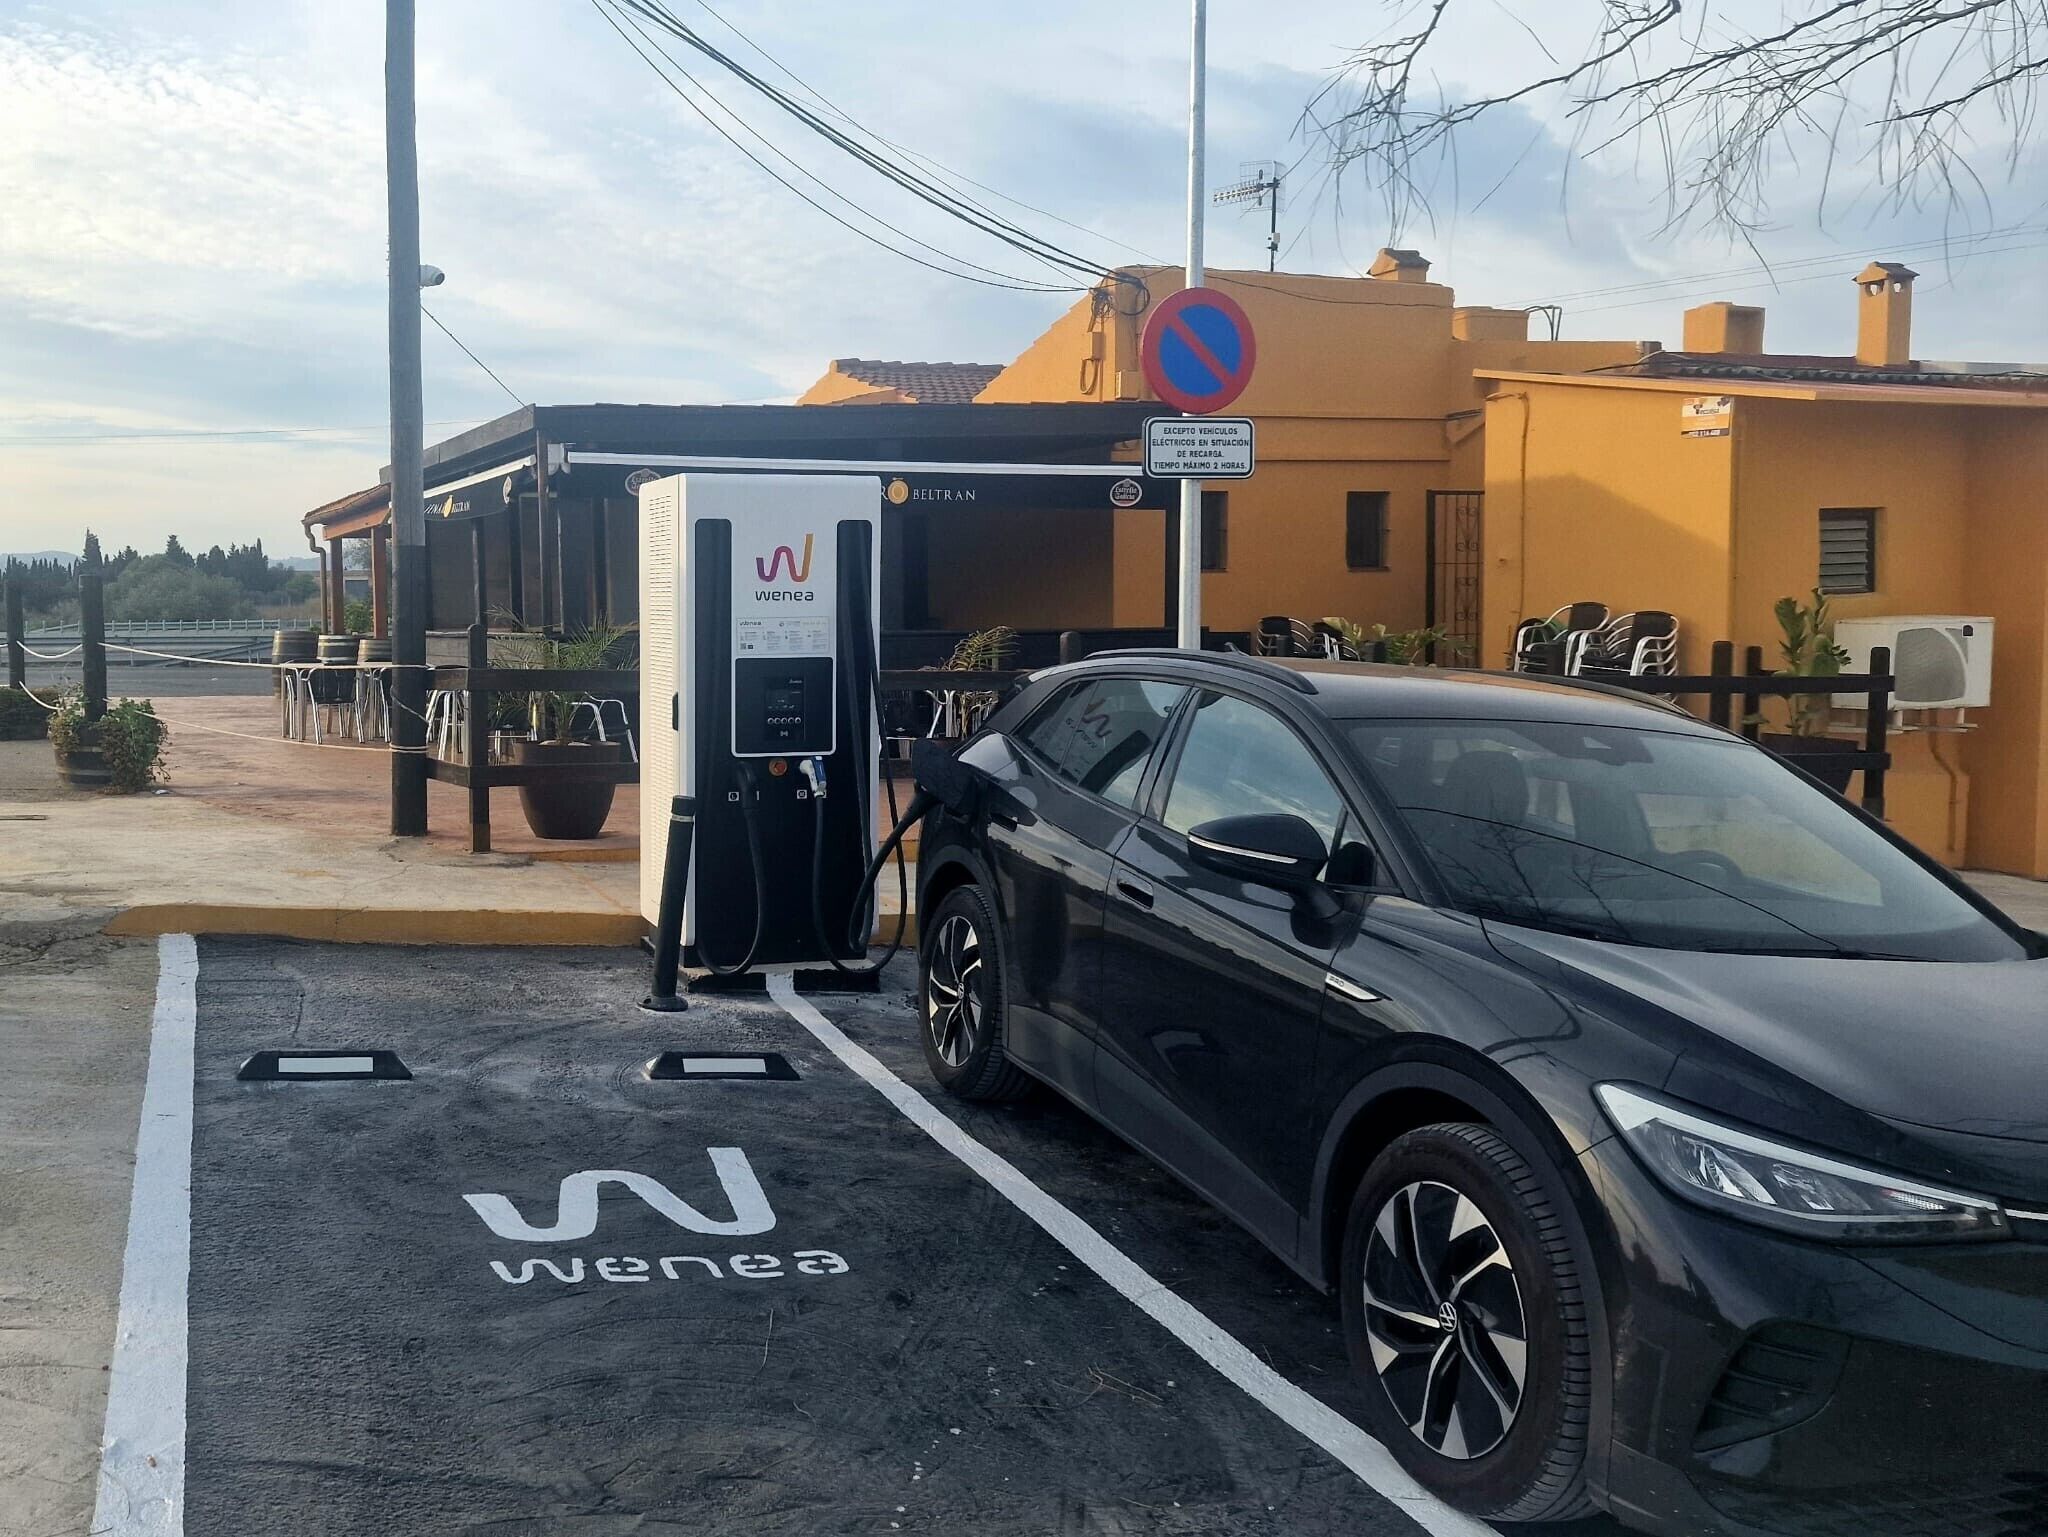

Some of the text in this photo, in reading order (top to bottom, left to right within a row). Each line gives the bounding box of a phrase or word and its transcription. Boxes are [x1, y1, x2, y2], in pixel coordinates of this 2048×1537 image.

[1164, 427, 1195, 435] EXCEPTO
[1152, 438, 1196, 446] ELÉCTRICOS
[1211, 438, 1249, 446] SITUACIÓN
[1183, 461, 1211, 469] MÁXIMO
[913, 488, 975, 501] BELTRAN
[755, 591, 814, 601] wenea
[490, 1250, 850, 1284] wenea
